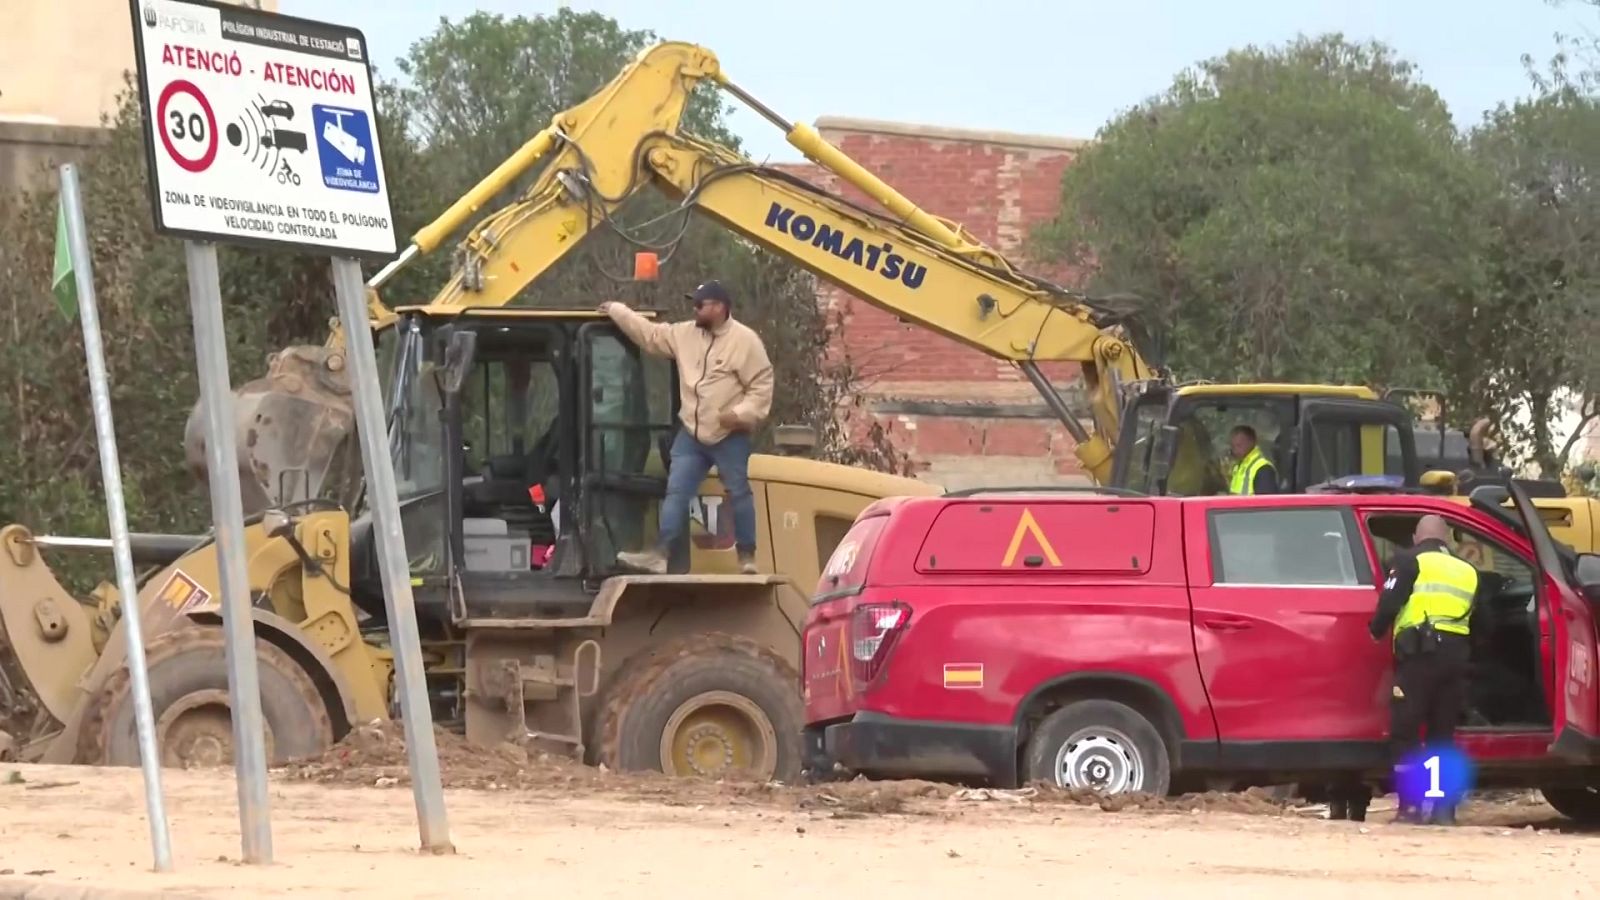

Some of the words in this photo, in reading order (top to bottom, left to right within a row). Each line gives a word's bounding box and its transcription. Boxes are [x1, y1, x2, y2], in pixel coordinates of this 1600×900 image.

[255, 27, 298, 45] INDUSTRIAL
[299, 34, 309, 47] DE
[162, 43, 242, 76] ATENCIÓ
[264, 61, 355, 95] ATENCIÓN
[170, 110, 205, 142] 30
[165, 190, 191, 205] ZONA
[194, 194, 206, 207] DE
[209, 196, 285, 217] VIDEOVIGILANCIA
[286, 206, 300, 218] EN
[302, 207, 327, 222] TODO
[329, 211, 340, 224] EL
[342, 212, 389, 230] POLÍGONO
[224, 215, 274, 233] VELOCIDAD
[277, 222, 338, 240] CONTROLADA
[765, 201, 927, 290] KOMATSU
